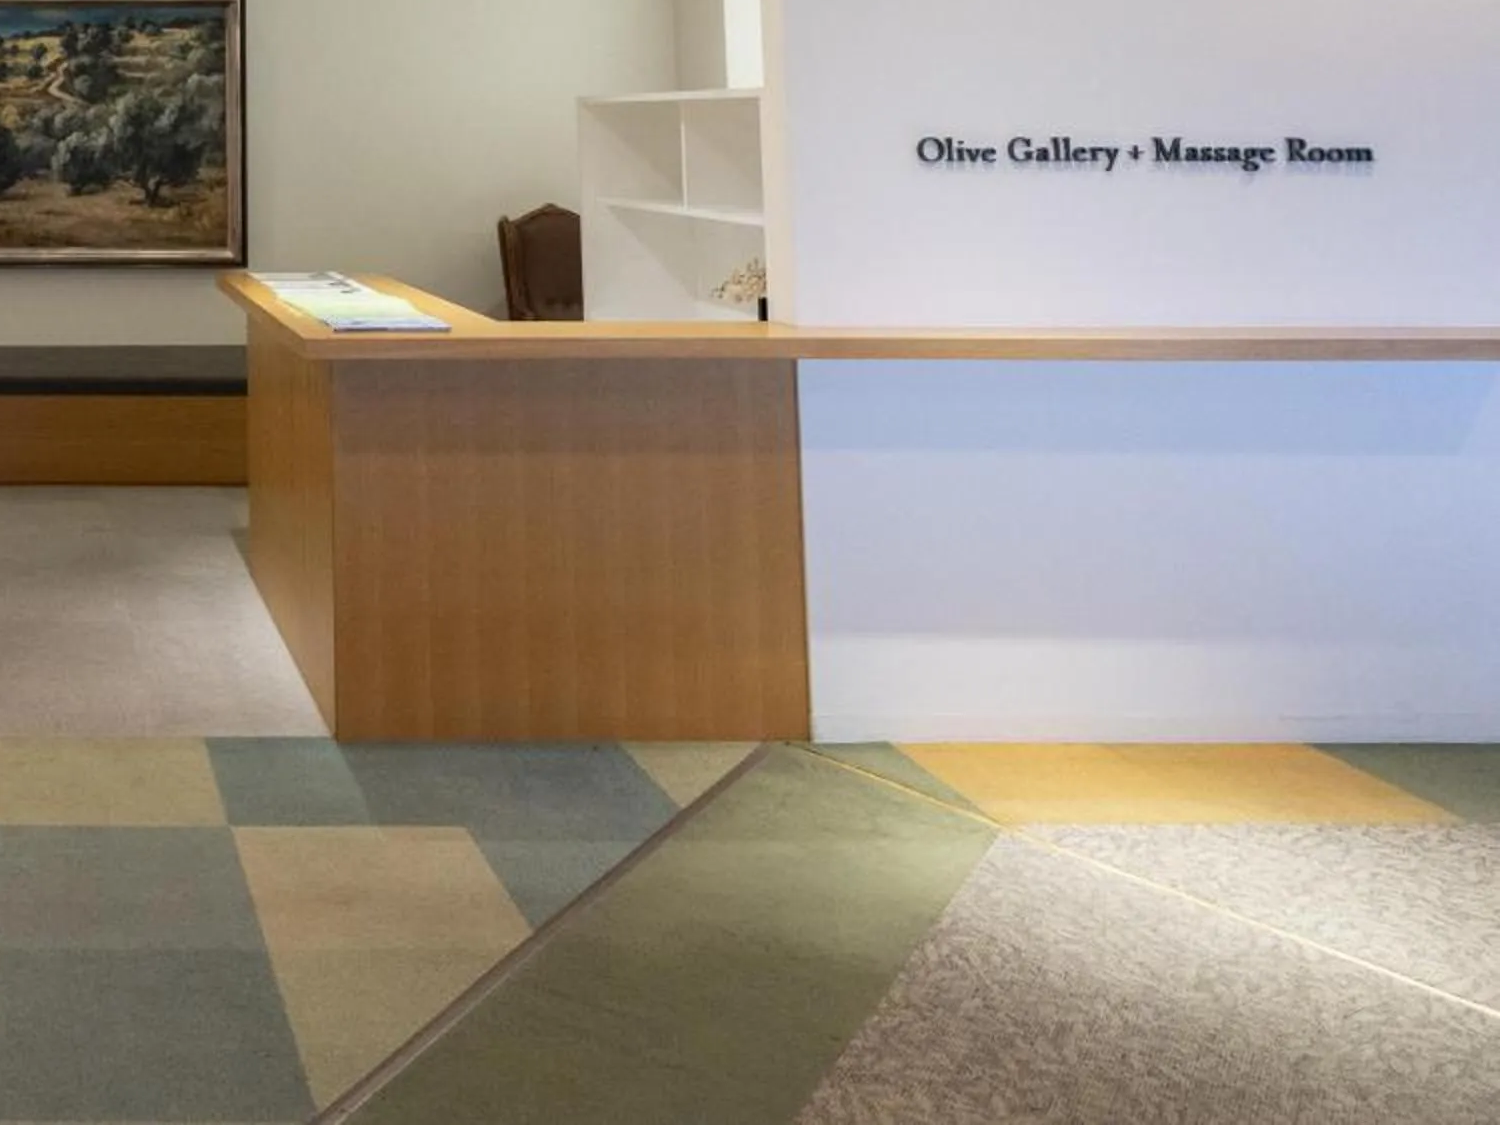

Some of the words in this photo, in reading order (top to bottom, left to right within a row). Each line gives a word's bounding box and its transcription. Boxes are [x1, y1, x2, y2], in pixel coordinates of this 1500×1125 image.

[916, 136, 997, 163] Olive
[1007, 136, 1119, 172] Gallery
[1127, 144, 1144, 161] +
[1151, 136, 1276, 172] Massage
[1284, 136, 1373, 163] Room
